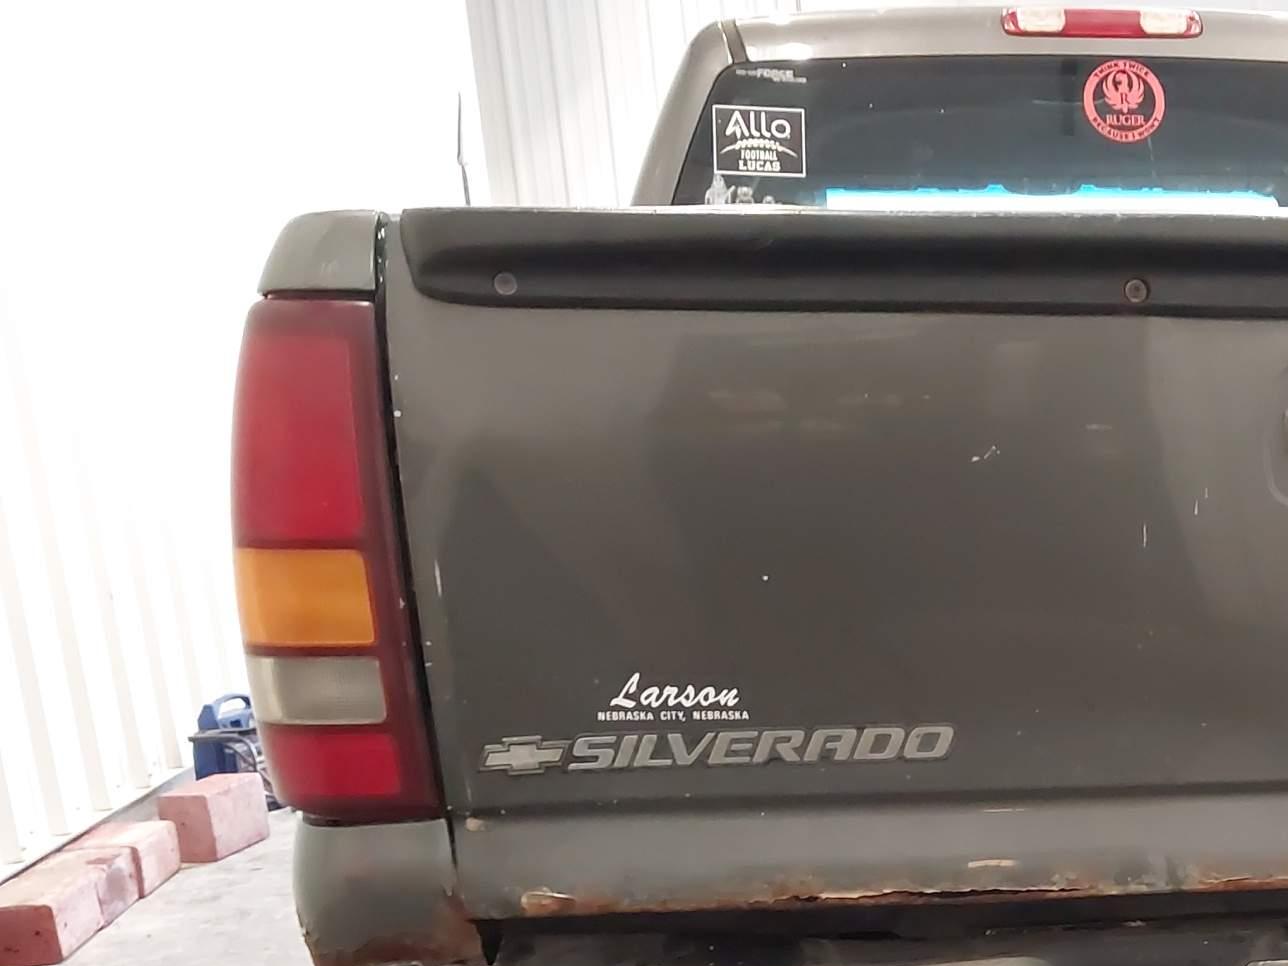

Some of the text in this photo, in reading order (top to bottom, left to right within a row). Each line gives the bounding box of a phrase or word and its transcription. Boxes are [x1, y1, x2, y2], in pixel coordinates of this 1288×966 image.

[1106, 113, 1146, 126] RUGER
[741, 149, 778, 160] FOOTBALL
[738, 160, 781, 171] LUCAS
[609, 672, 740, 708] Larson
[597, 710, 750, 722] NEBRASKA CITY, NEBRASKA
[565, 724, 956, 772] SILVERADO
